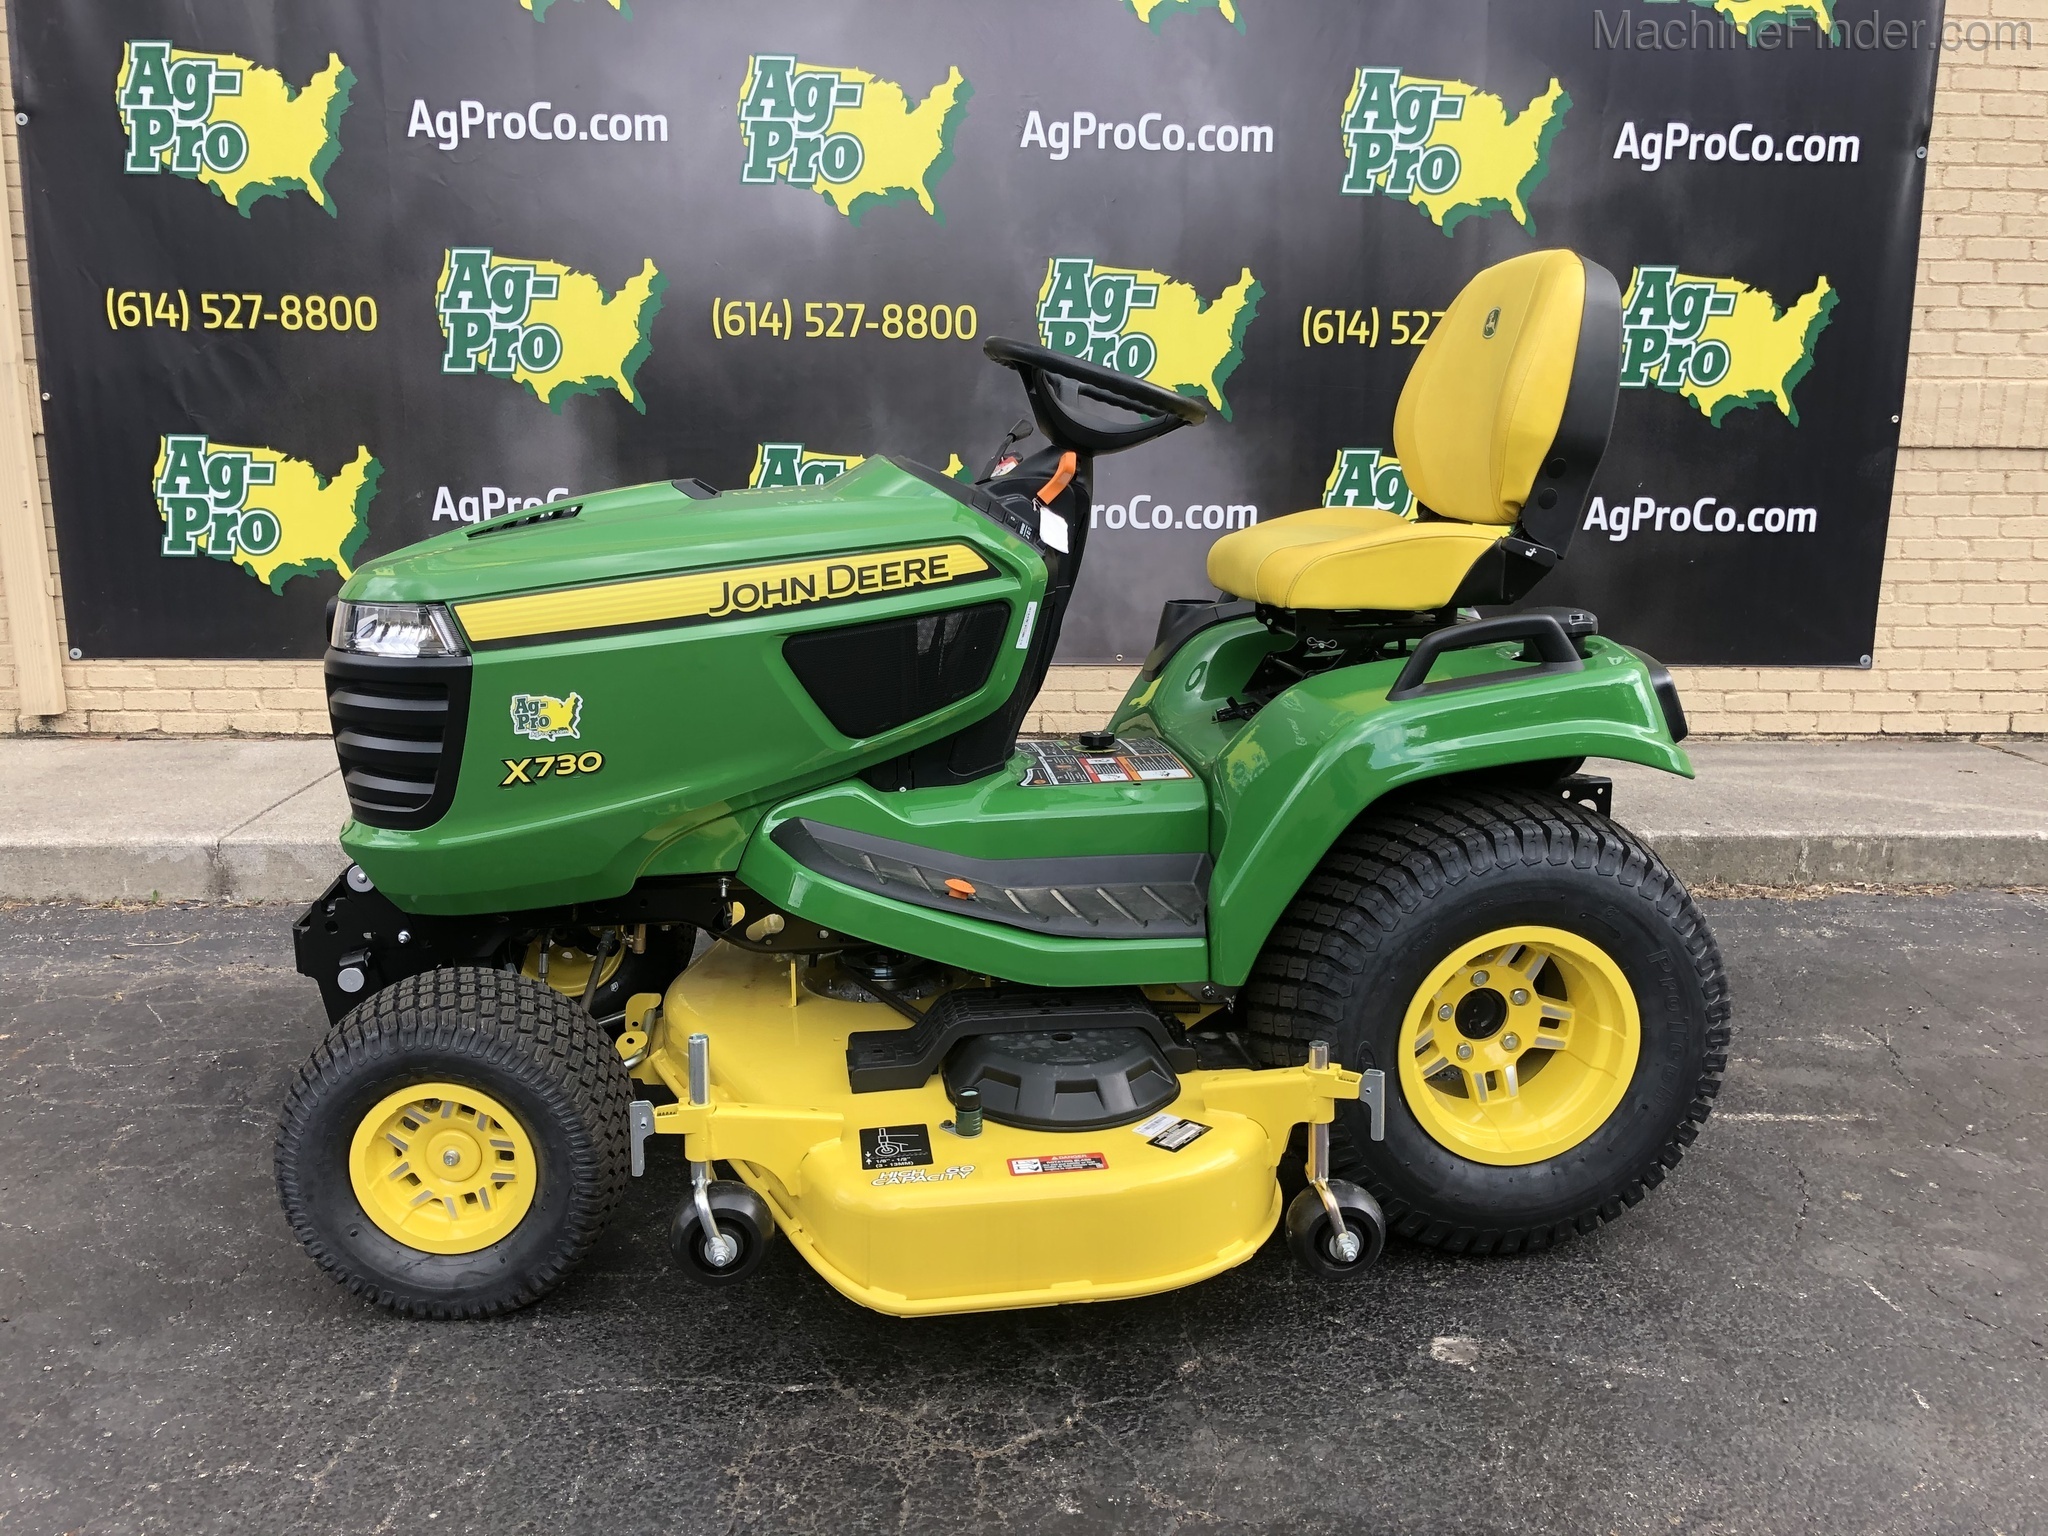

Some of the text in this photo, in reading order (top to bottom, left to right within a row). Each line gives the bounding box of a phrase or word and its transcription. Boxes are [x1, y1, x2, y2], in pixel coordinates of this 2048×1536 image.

[120, 40, 241, 121] Ag-
[741, 55, 864, 135] Ag-
[1344, 68, 1464, 139] Ag-
[126, 109, 248, 174] Pro
[408, 99, 668, 150] AgProCo.com
[742, 120, 862, 183] Pro
[1020, 111, 1274, 160] AgProCo.com
[1613, 122, 1860, 171] AgProCo.com
[1342, 131, 1460, 193] Pro
[106, 288, 378, 332] (614) 527-8800
[438, 248, 559, 325] Ag-
[1040, 258, 1157, 335] Ag-
[1623, 267, 1736, 341] Ag-
[445, 312, 562, 373] Pro
[712, 297, 978, 341] (614) 527-8800
[1302, 306, 1380, 348] (614)
[1044, 320, 1156, 379] Pro
[1620, 328, 1730, 387] Pro
[157, 435, 277, 509] Ag-
[1326, 450, 1414, 518] Ag
[162, 496, 281, 556] Pro
[1090, 494, 1258, 530] roCo.com
[1583, 496, 1817, 541] AgProCo.com
[708, 553, 949, 613] JOHN DEERE
[514, 696, 548, 716] Ag-
[516, 713, 550, 731] Pro
[501, 751, 603, 785] X730
[871, 1172, 972, 1186] CAPACITY
[879, 1165, 975, 1179] HIGH 60
